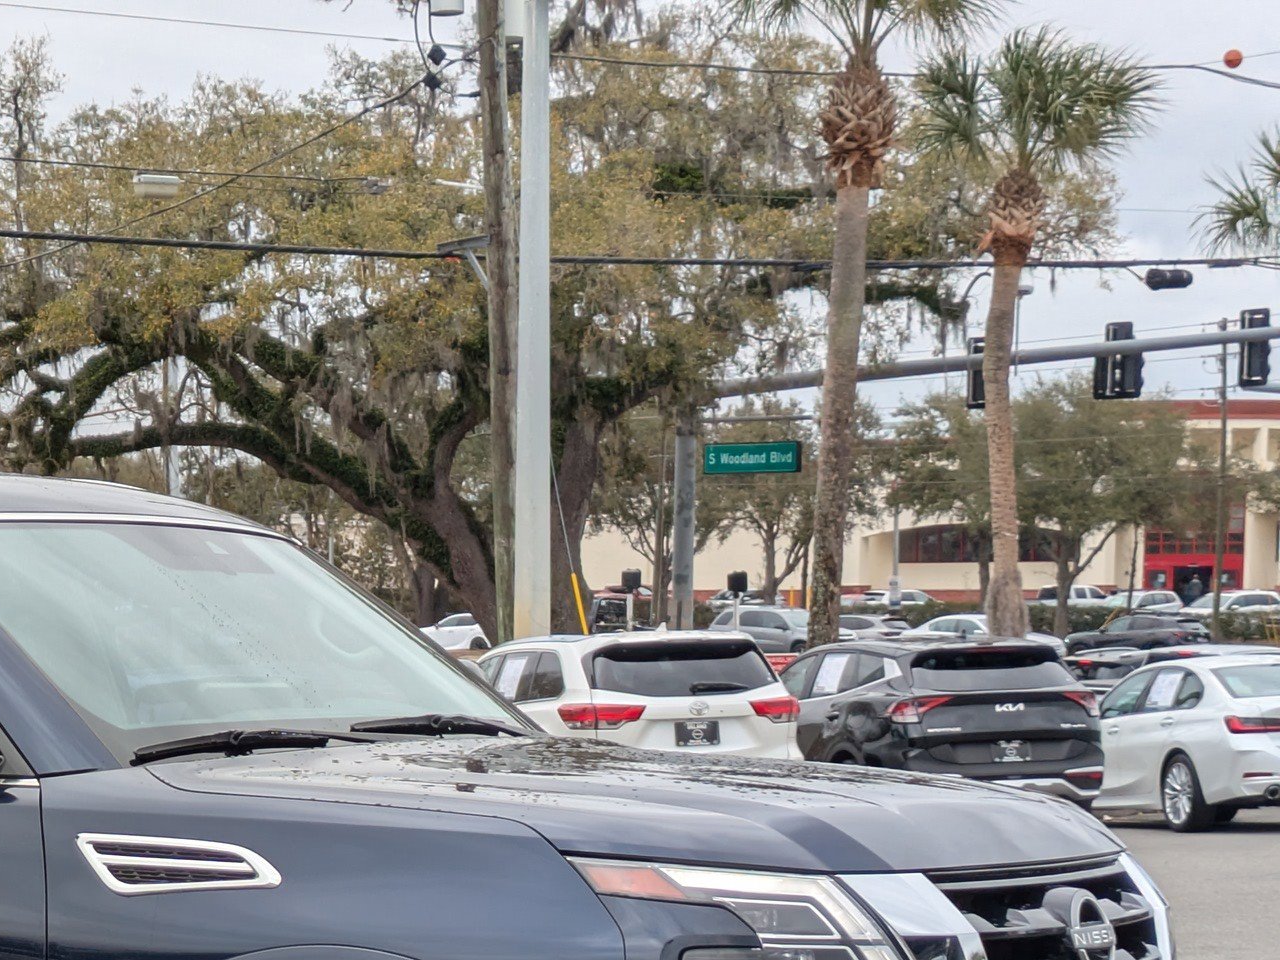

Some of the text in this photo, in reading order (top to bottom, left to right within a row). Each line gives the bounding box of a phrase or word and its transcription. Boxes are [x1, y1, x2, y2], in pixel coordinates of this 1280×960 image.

[709, 451, 793, 465] S Woodland Blvd
